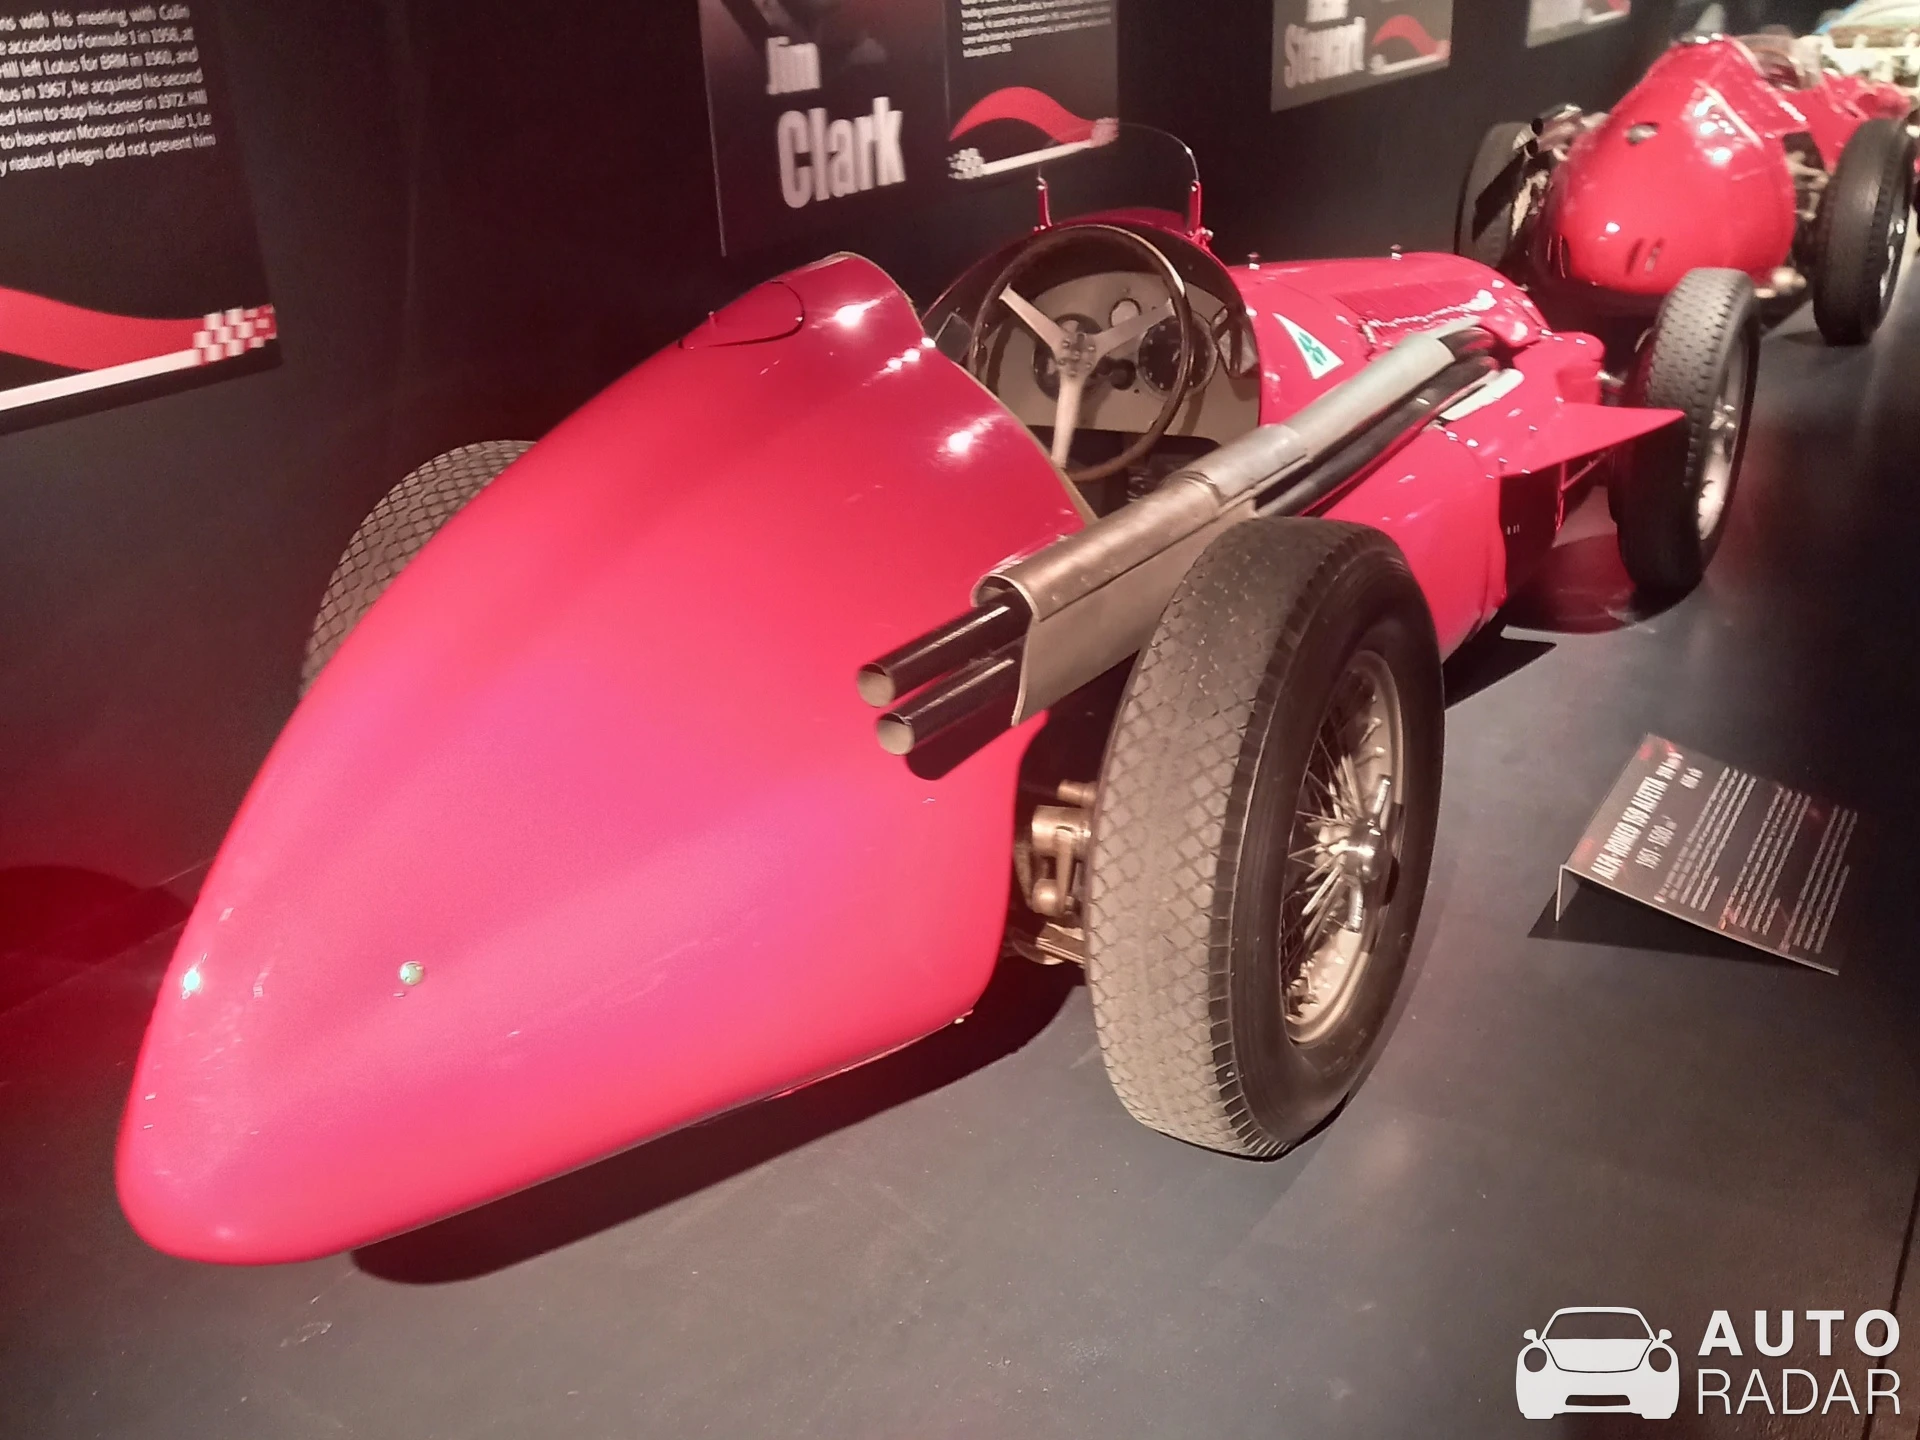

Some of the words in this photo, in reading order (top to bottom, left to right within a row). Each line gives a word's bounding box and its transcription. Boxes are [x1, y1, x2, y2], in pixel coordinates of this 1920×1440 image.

[19, 10, 50, 30] with
[52, 10, 74, 28] his
[77, 9, 128, 28] meeting
[128, 5, 157, 22] with
[8, 33, 62, 55] acceded
[62, 34, 78, 50] to
[128, 29, 138, 46] 1
[137, 29, 152, 44] in
[20, 57, 43, 78] left
[43, 58, 81, 76] Lotus
[80, 53, 98, 72] for
[128, 52, 144, 68] in
[175, 45, 199, 64] and
[766, 33, 821, 95] Jim
[21, 83, 36, 100] in
[71, 77, 89, 95] he
[91, 74, 142, 96] acquired
[142, 72, 162, 89] his
[161, 67, 204, 87] second
[15, 106, 44, 124] him
[43, 106, 60, 122] to
[58, 104, 88, 121] stop
[86, 99, 107, 117] his
[106, 98, 144, 115] career
[143, 95, 158, 110] in
[0, 134, 16, 150] to
[14, 129, 48, 148] have
[48, 128, 77, 144] won
[76, 120, 126, 140] Monaco
[125, 119, 139, 135] in
[137, 112, 187, 133] Formule
[8, 150, 56, 172] natural
[56, 147, 105, 170] phlegm
[104, 141, 126, 160] did
[126, 139, 150, 157] not
[148, 134, 193, 158] prevent
[192, 131, 217, 149] him
[777, 96, 906, 208] Clark
[1590, 821, 1642, 881] ALFA-ROMEO
